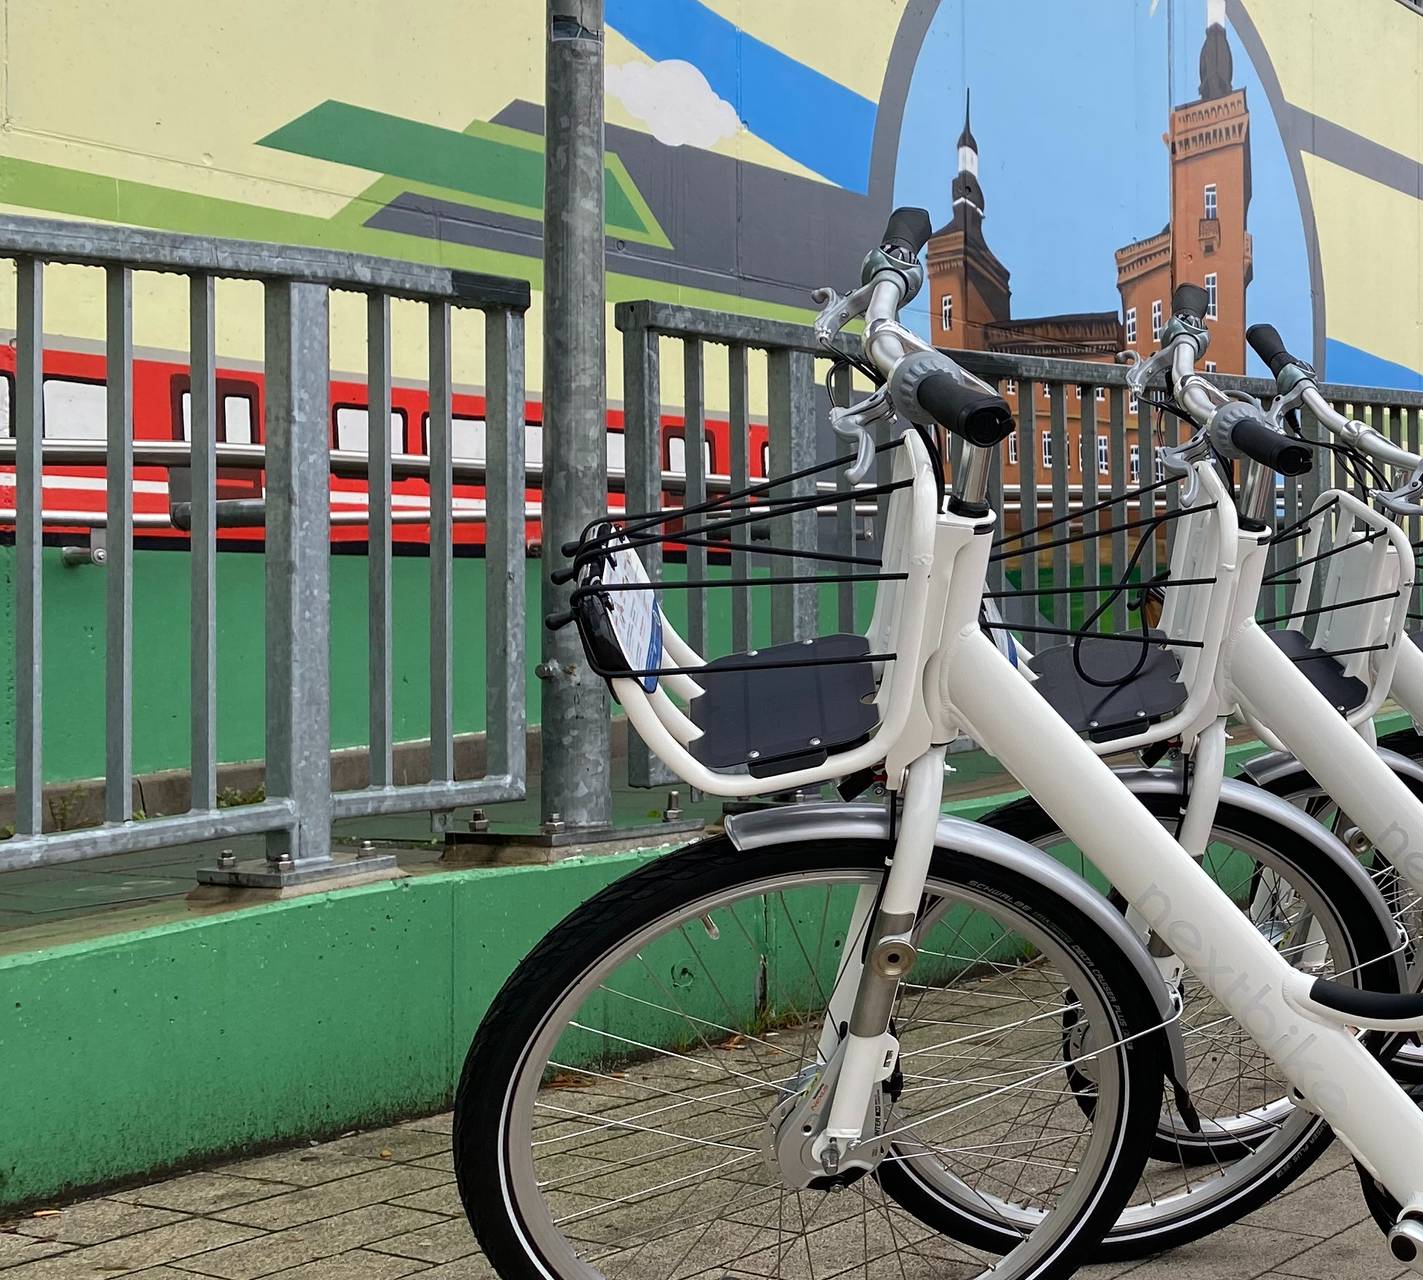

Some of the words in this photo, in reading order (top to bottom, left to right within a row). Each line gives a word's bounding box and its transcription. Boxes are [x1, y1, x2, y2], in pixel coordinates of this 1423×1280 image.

[968, 880, 1032, 911] SCHWALBE
[1113, 1004, 1128, 1030] PLUS
[1130, 883, 1348, 1116] nextbike
